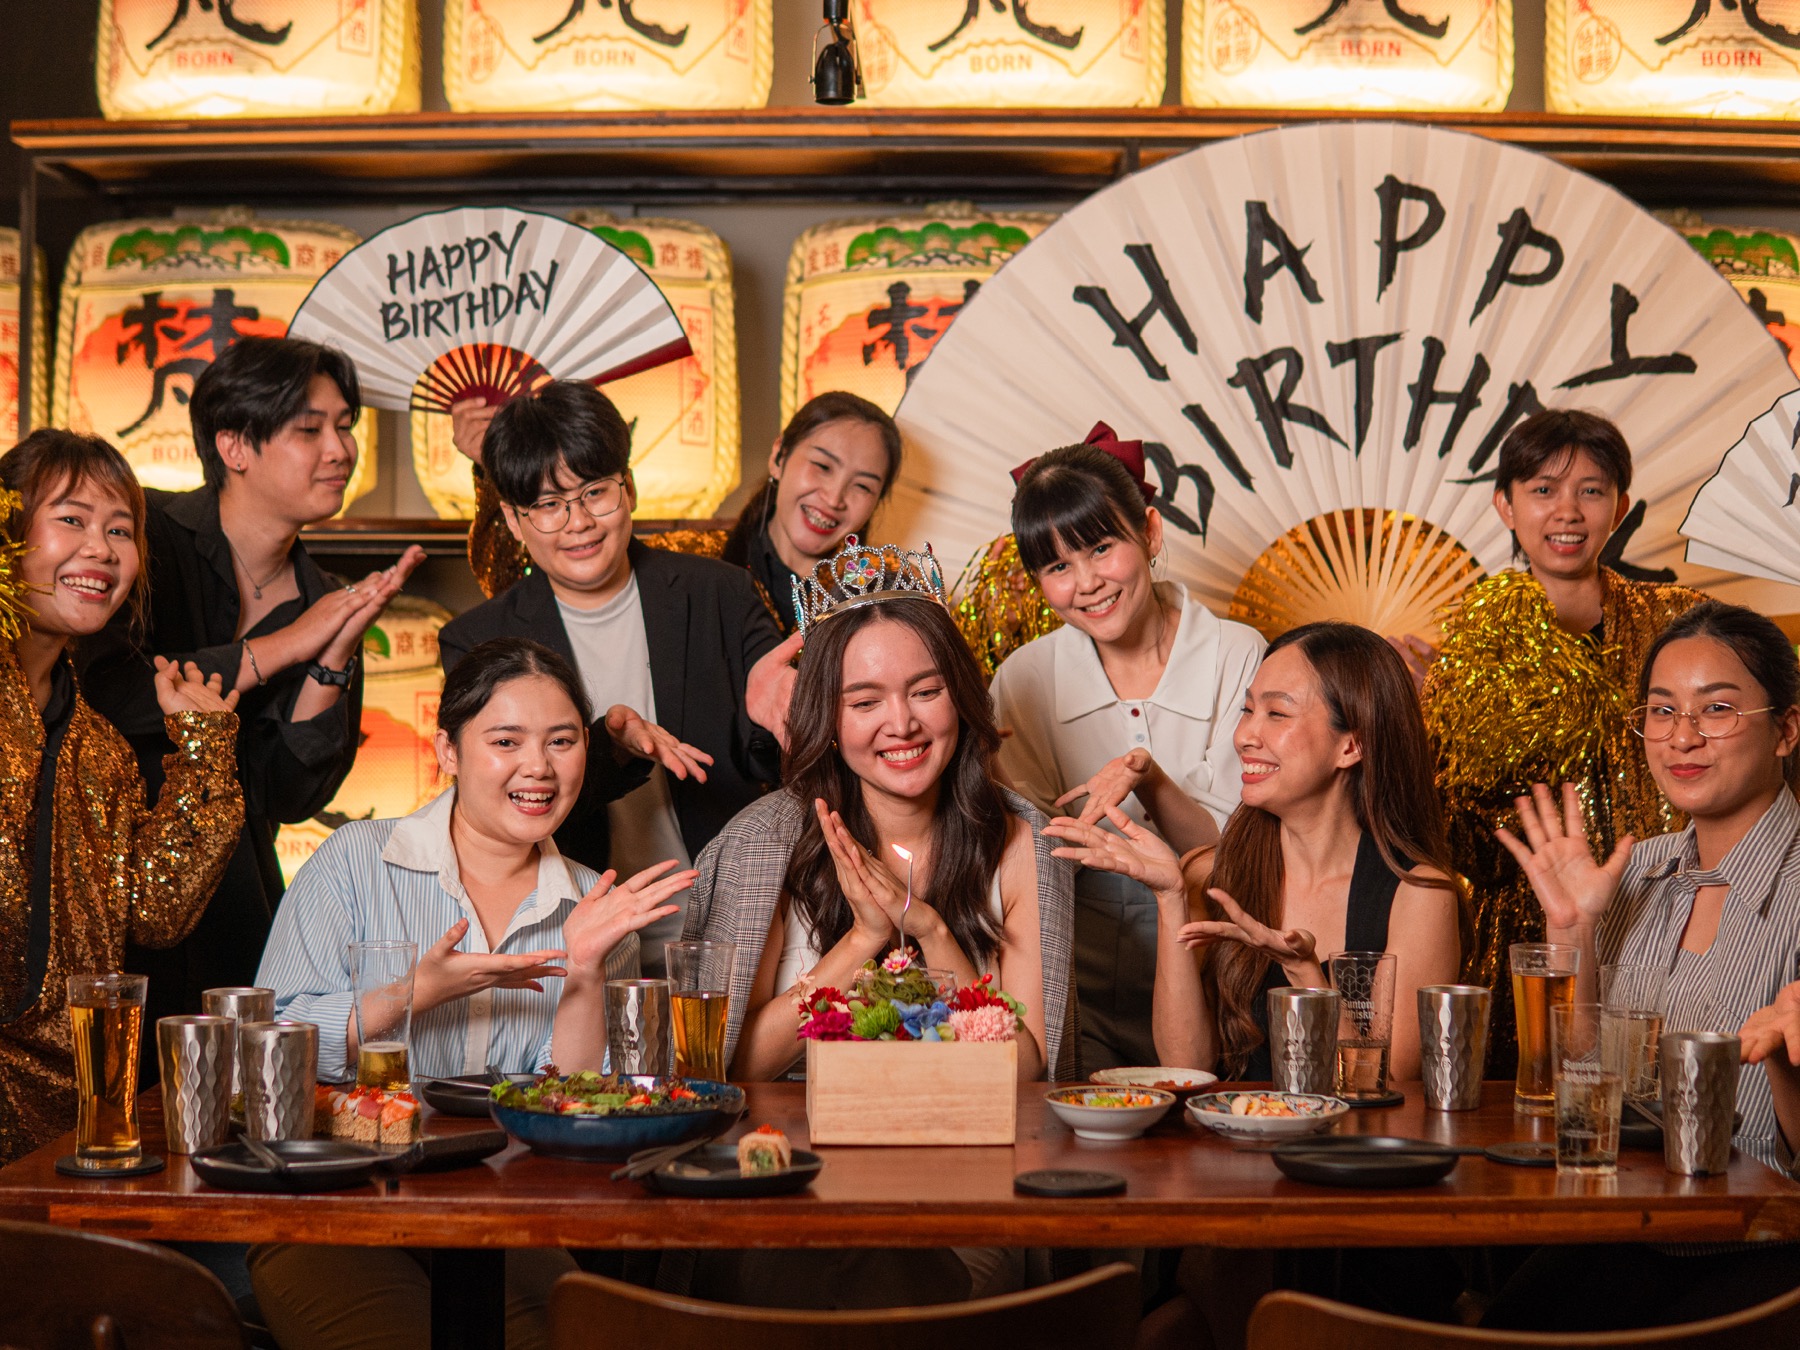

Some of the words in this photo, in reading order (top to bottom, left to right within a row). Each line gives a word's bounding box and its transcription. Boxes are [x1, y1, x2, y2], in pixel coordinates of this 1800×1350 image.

[574, 48, 636, 66] BORN
[1341, 39, 1401, 58] BORN
[176, 51, 234, 68] BORN
[970, 54, 1032, 72] BORN
[1702, 49, 1762, 67] BORN
[387, 220, 528, 295] HAPPY
[1073, 174, 1697, 390] HAPPY
[379, 259, 559, 343] BIRTHDAY
[151, 445, 197, 463] BOR
[276, 840, 318, 857] ORN
